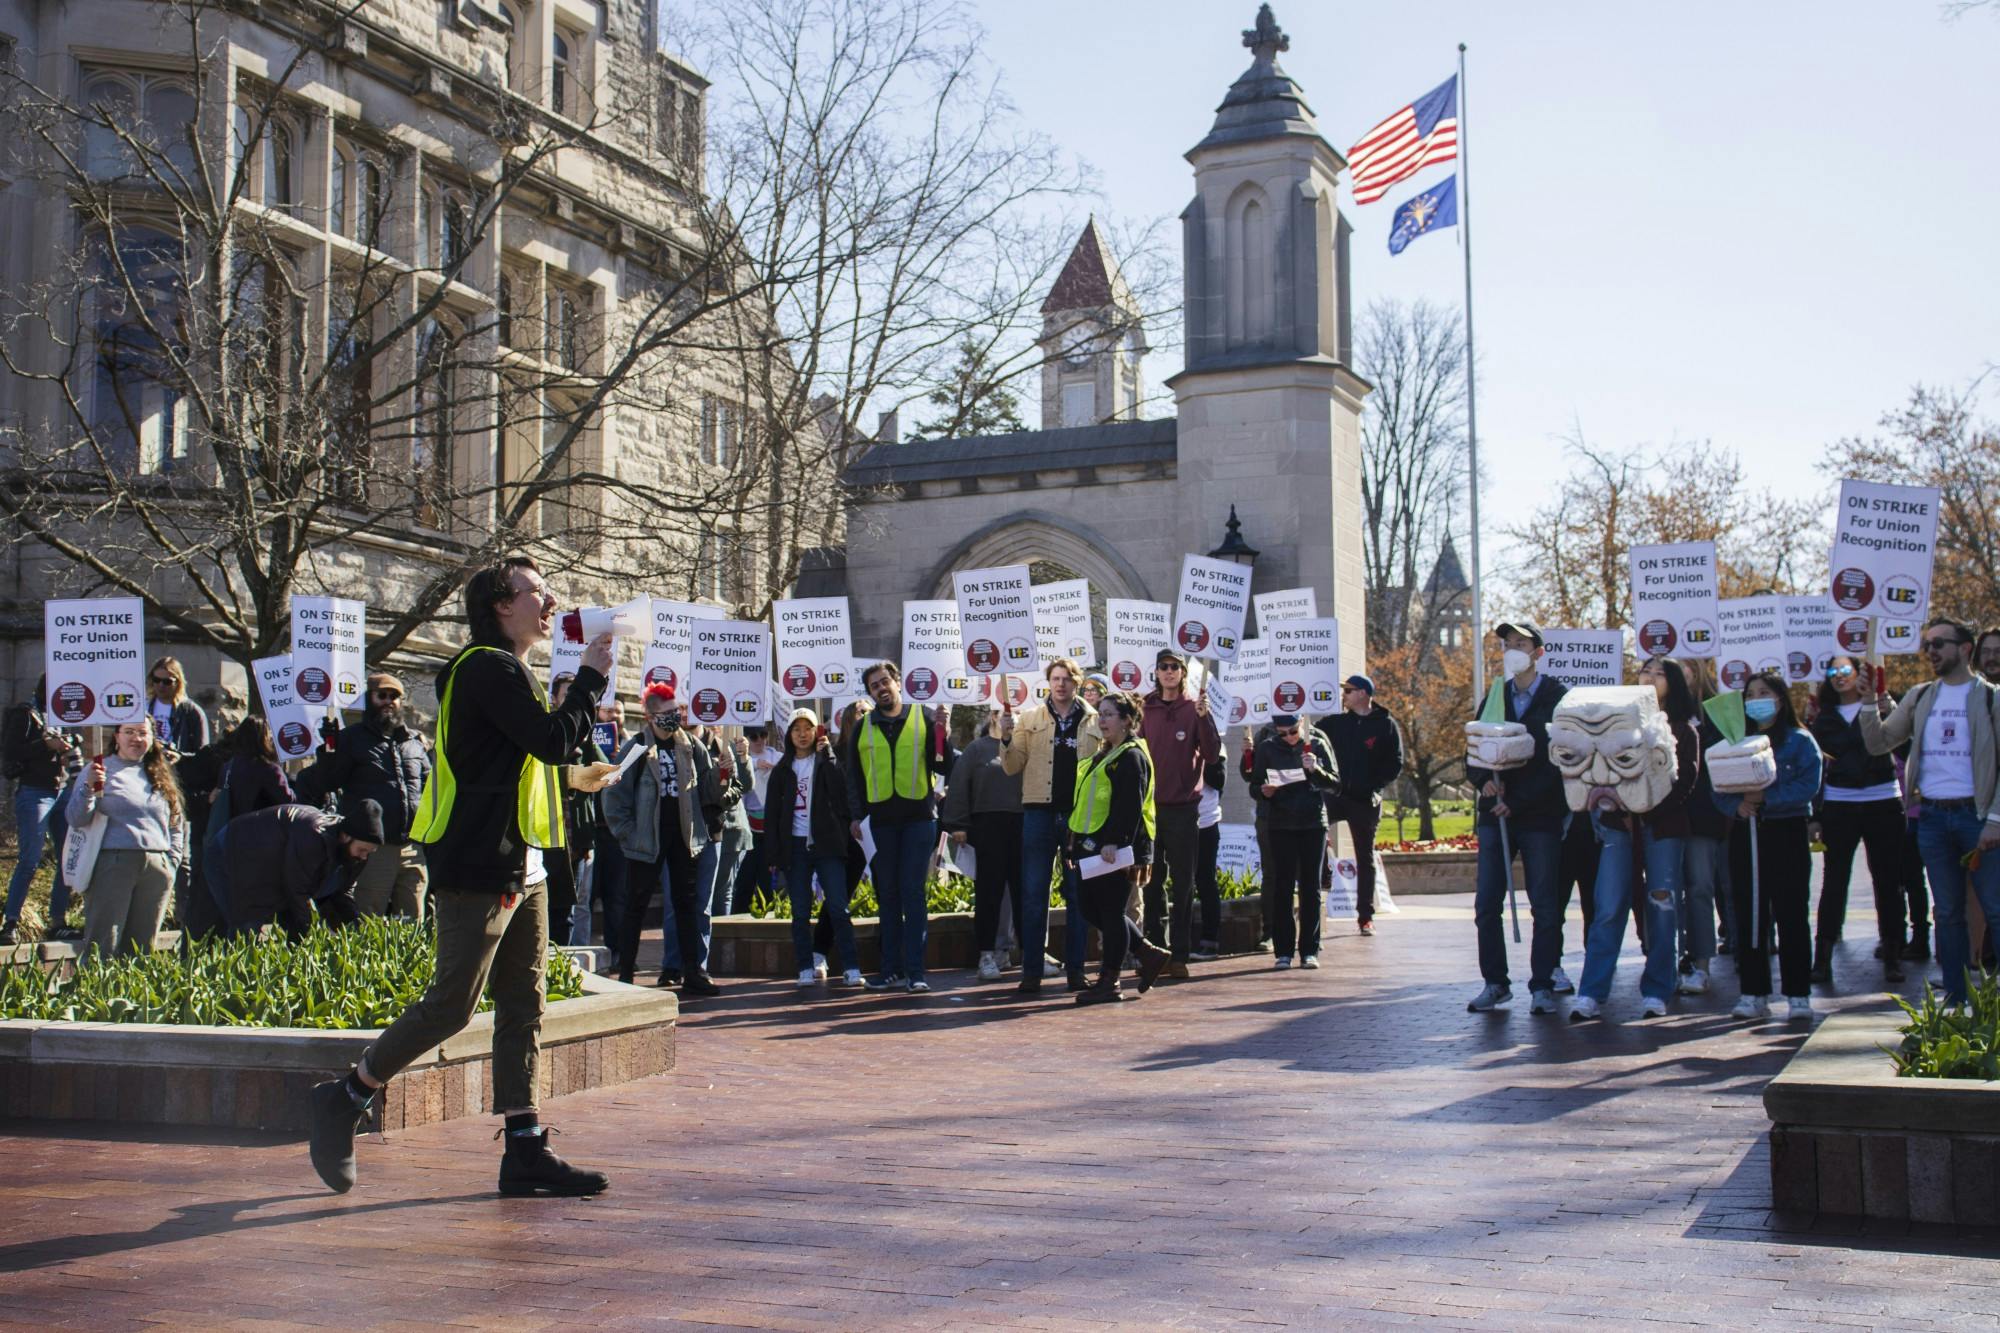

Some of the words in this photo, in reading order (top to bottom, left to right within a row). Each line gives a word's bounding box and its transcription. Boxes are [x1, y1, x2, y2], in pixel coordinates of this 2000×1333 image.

[1848, 496, 1868, 510] ON
[1872, 499, 1928, 516] STRIKE
[1850, 515, 1872, 528] For
[1877, 519, 1920, 533] Union
[1841, 532, 1927, 552] Recognition
[1639, 560, 1658, 570] ON
[1662, 556, 1707, 568] STRIKE
[1190, 568, 1206, 578] ON
[1208, 571, 1245, 586] STRIKE
[1645, 575, 1664, 585] For
[1668, 572, 1704, 584] Union
[963, 584, 980, 593] ON
[982, 580, 1022, 592] STRIKE
[1192, 582, 1208, 593] For
[1212, 585, 1240, 598] Union
[1033, 595, 1046, 604] ON
[1048, 590, 1082, 602] STRIKE
[1639, 588, 1711, 601] Recognition
[968, 598, 986, 607] For
[990, 595, 1020, 606] Union
[1184, 594, 1243, 613] Recognition
[1261, 602, 1274, 611] ON
[1276, 598, 1309, 608] STRIKE
[1054, 604, 1080, 613] Union
[1719, 612, 1734, 620] ON
[1738, 606, 1776, 618] STRIKE
[1786, 606, 1800, 614] ON
[55, 616, 76, 626] ON
[80, 614, 132, 626] STRIKE
[300, 610, 318, 620] ON
[322, 611, 358, 624] STRIKE
[657, 612, 673, 622] ON
[782, 612, 798, 622] ON
[802, 610, 842, 620] STRIKE
[912, 614, 927, 622] ON
[965, 610, 1028, 622] Recognition
[1116, 611, 1130, 620] ON
[1132, 612, 1165, 622] STRIKE
[304, 624, 324, 634] For
[328, 626, 354, 638] Union
[660, 626, 676, 636] For
[787, 626, 804, 634] For
[808, 624, 838, 633] Union
[915, 628, 932, 636] For
[1120, 624, 1134, 632] For
[1138, 625, 1164, 634] Union
[1724, 624, 1740, 632] For
[1744, 620, 1774, 630] Union
[60, 633, 82, 644] For
[88, 632, 128, 642] Union
[698, 632, 716, 642] ON
[719, 633, 761, 644] STRIKE
[1276, 630, 1290, 640] ON
[1294, 630, 1332, 640] STRIKE
[298, 639, 360, 653] Recognition
[782, 638, 846, 650] Recognition
[1114, 636, 1168, 648] Recognition
[1280, 644, 1296, 653] For
[1299, 642, 1328, 652] Union
[1544, 642, 1562, 652] ON
[1567, 643, 1614, 654] STRIKE
[53, 649, 136, 662] Recognition
[702, 648, 720, 657] For
[724, 648, 756, 658] Union
[695, 661, 762, 674] Recognition
[1244, 662, 1266, 670] Union
[1274, 656, 1334, 668] Recognition
[1548, 658, 1568, 668] For
[1572, 658, 1608, 669] Union
[264, 670, 280, 680] ON
[1224, 672, 1270, 682] Recognition
[272, 684, 288, 694] For
